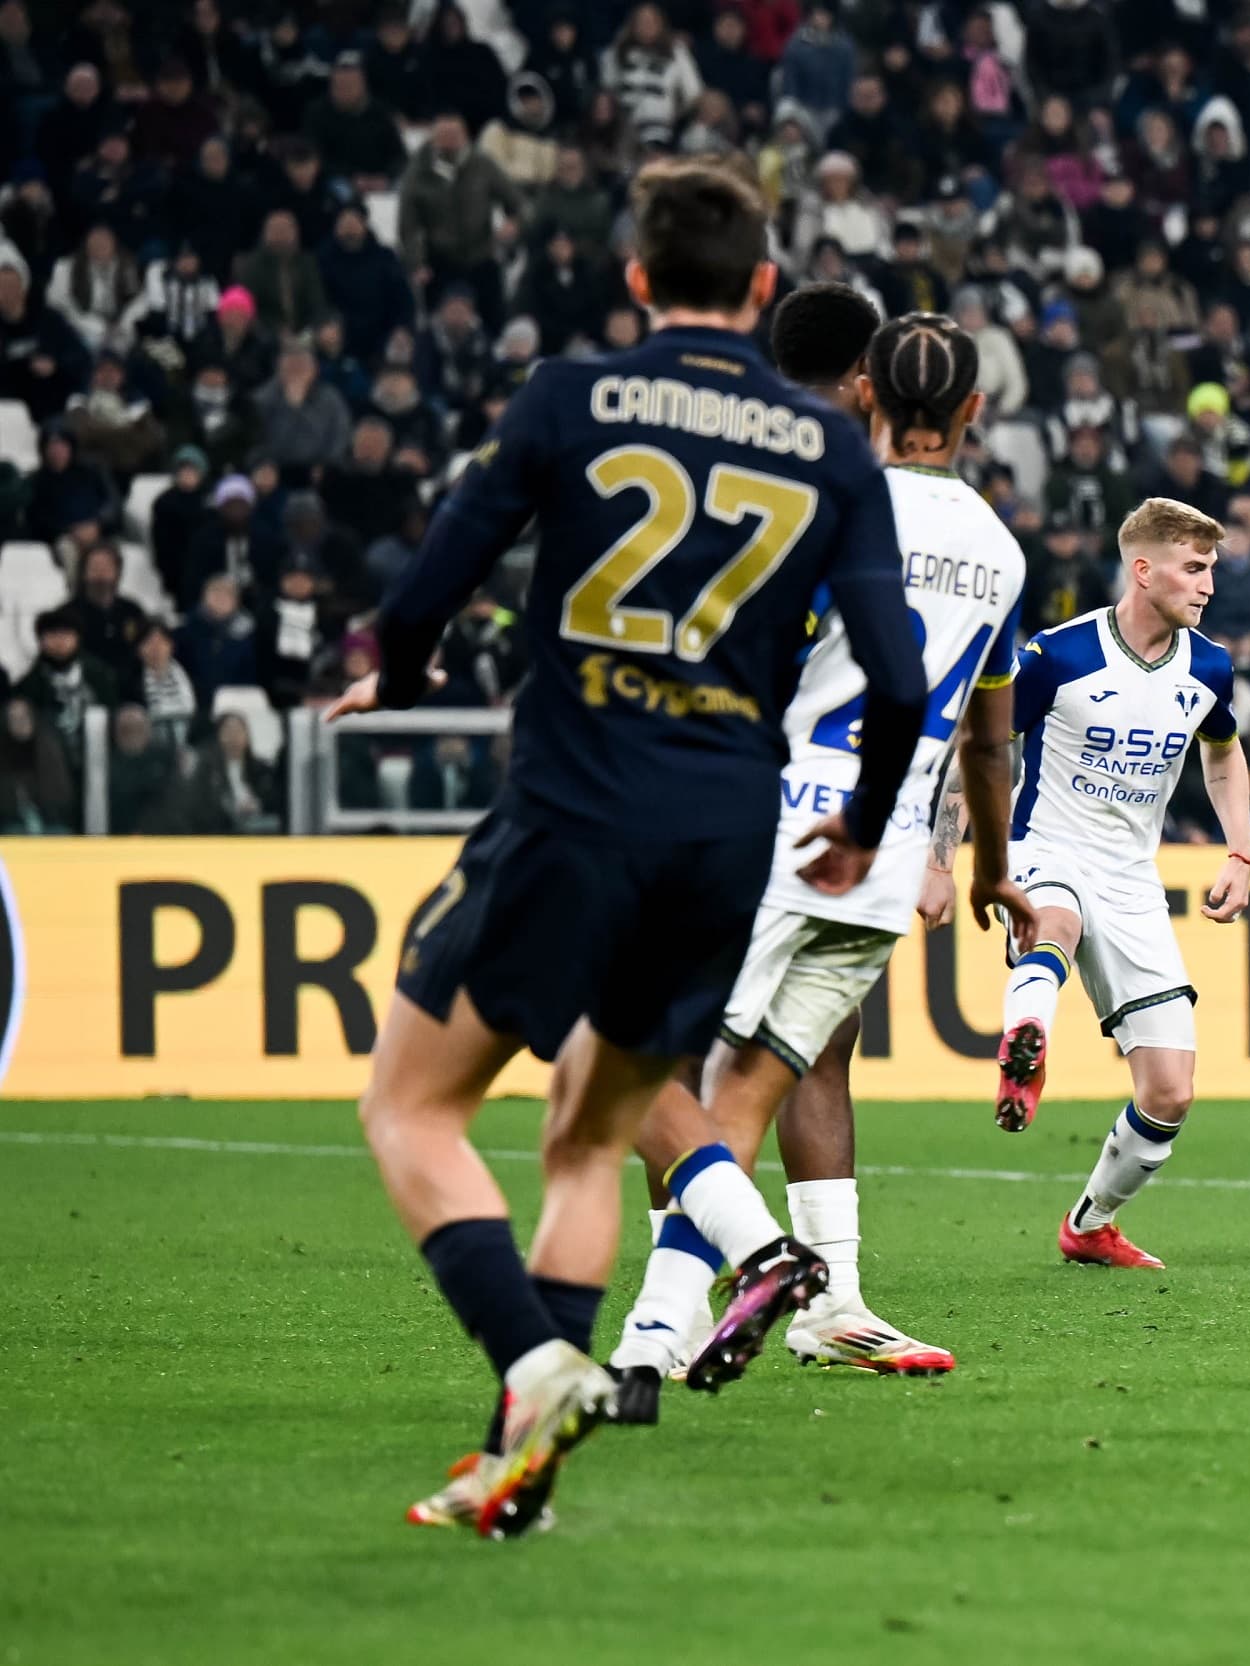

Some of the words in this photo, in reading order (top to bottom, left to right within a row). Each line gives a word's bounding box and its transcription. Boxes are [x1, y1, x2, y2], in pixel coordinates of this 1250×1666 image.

[591, 375, 825, 461] CAMBIASO
[559, 444, 818, 662] 27
[904, 552, 1000, 606] ERNEDE
